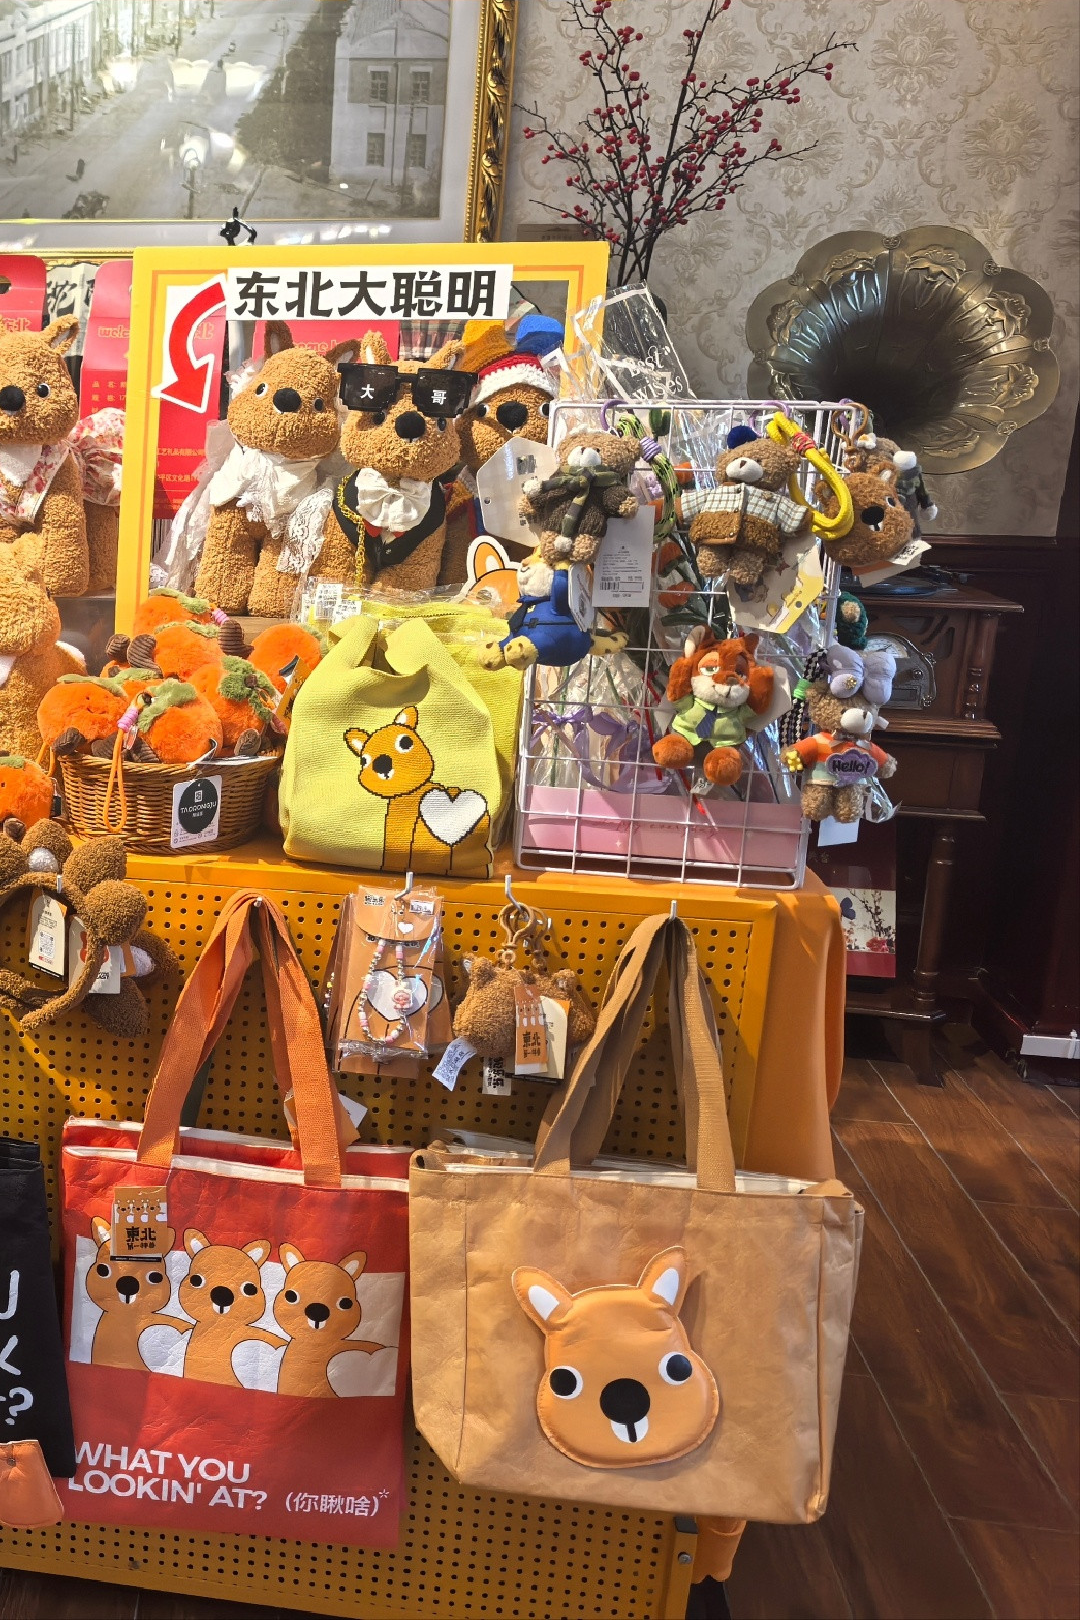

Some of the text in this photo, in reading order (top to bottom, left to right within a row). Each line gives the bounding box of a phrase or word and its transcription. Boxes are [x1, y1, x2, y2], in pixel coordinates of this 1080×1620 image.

[233, 269, 498, 318] 东北大聪明
[359, 383, 448, 406] 大 哥
[831, 755, 870, 775] Hello!
[125, 1225, 157, 1243] 東北
[74, 1440, 251, 1484] WHAT YOU
[68, 1469, 203, 1504] LOOKIN'
[208, 1488, 268, 1511] AT?
